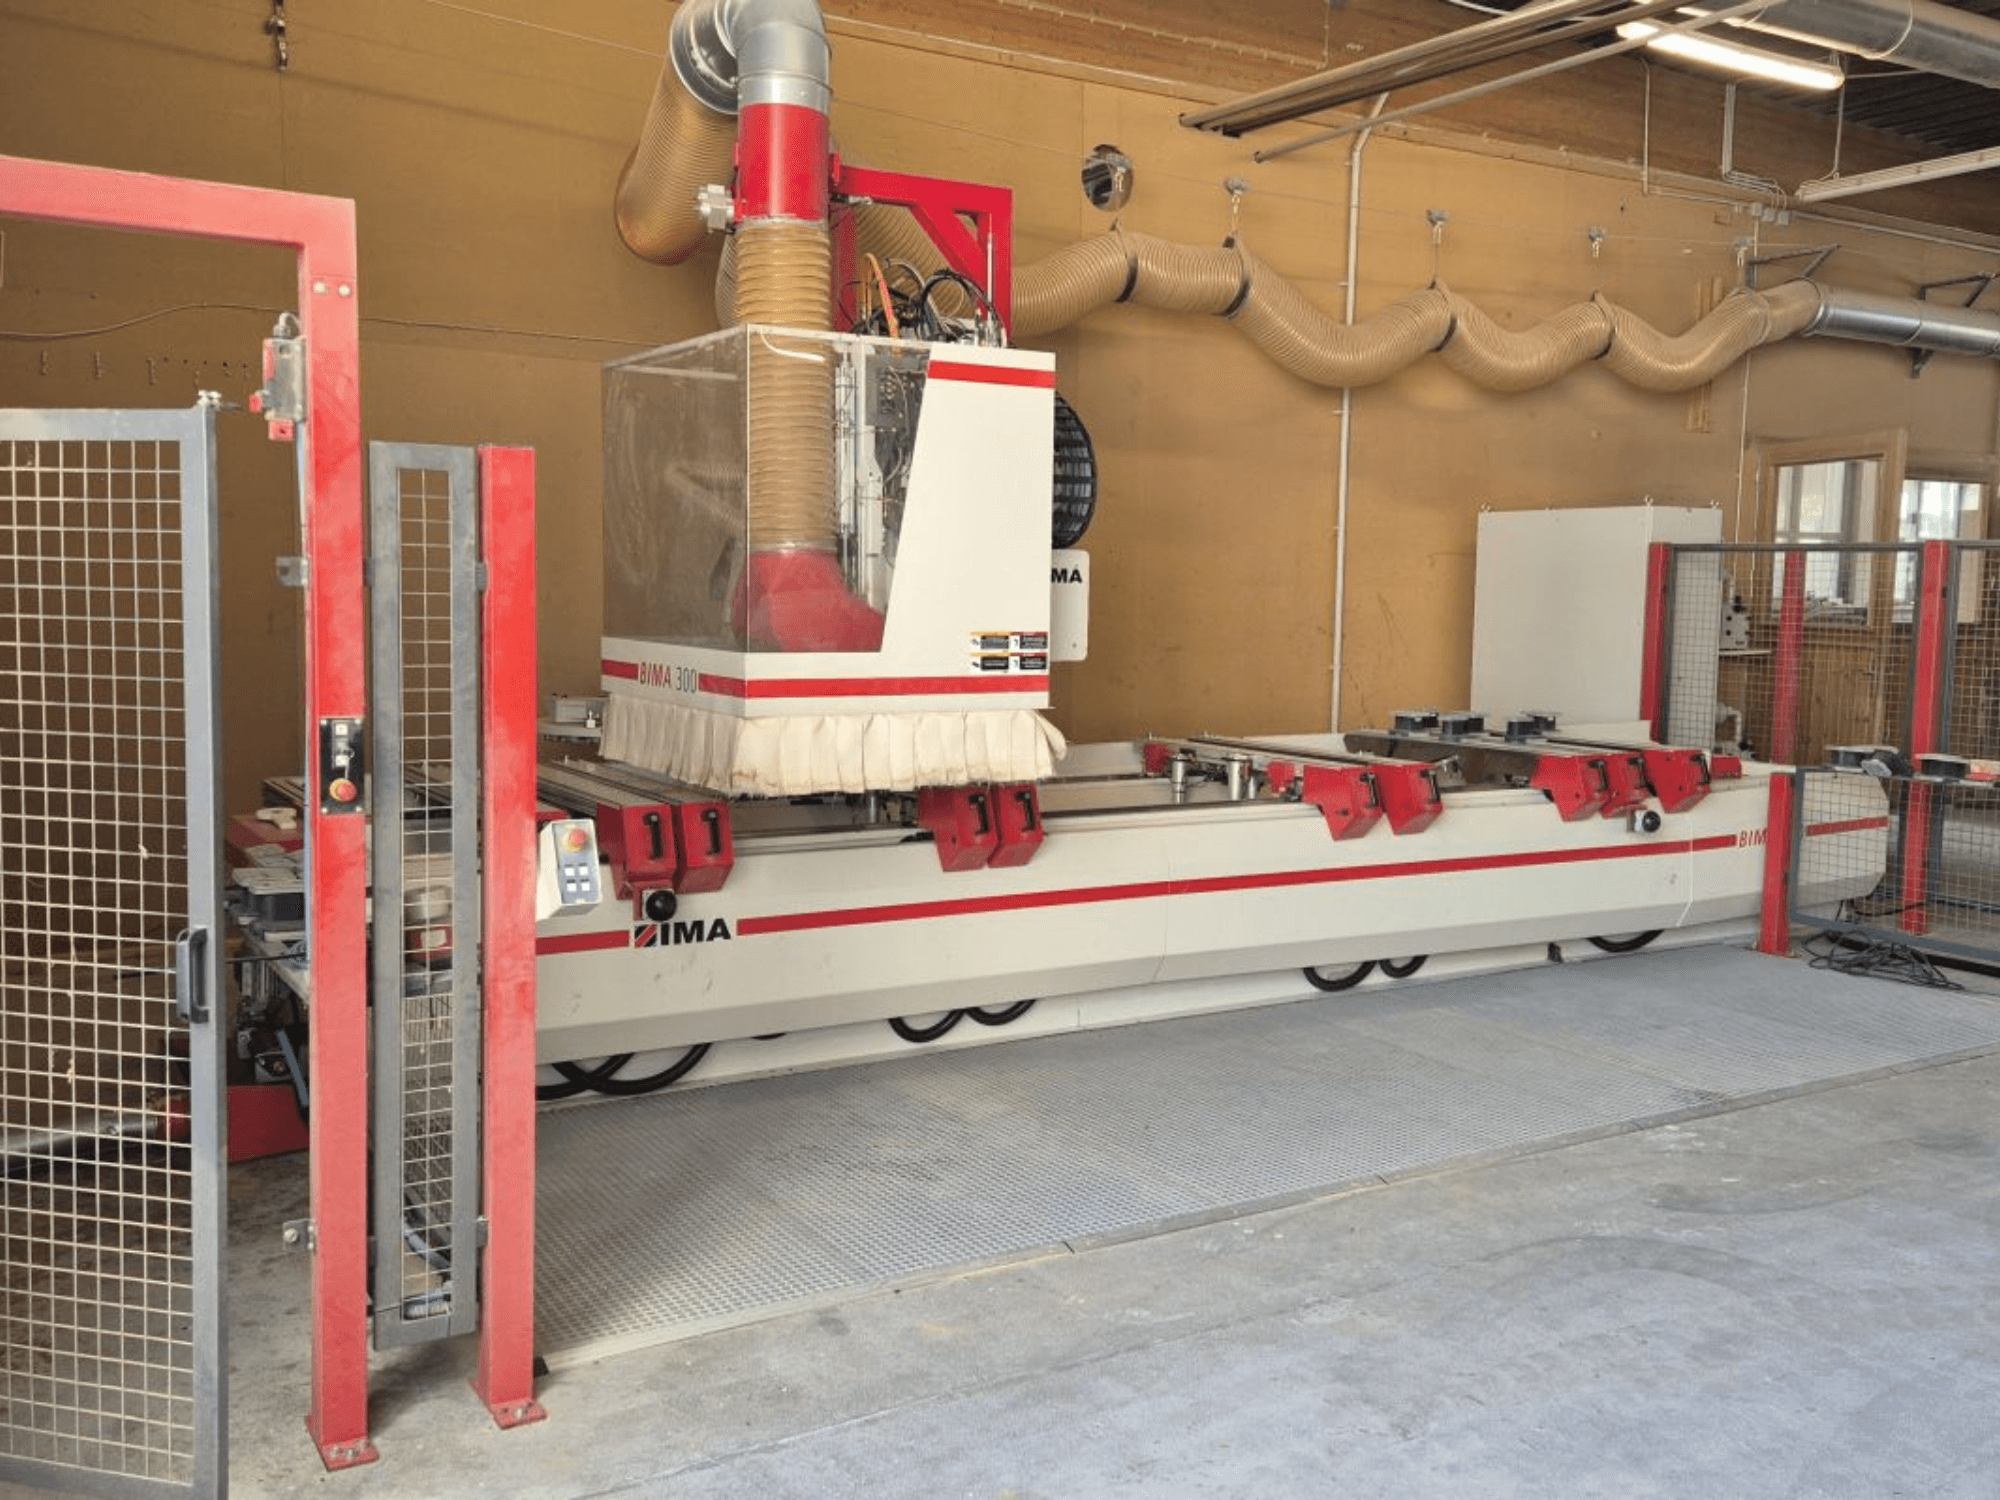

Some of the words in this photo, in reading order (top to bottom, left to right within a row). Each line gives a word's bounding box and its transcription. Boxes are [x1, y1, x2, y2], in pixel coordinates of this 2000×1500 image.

[1051, 567, 1082, 583] MA
[639, 661, 671, 688] BIMA
[675, 666, 698, 694] 300
[1739, 827, 1767, 848] BIM
